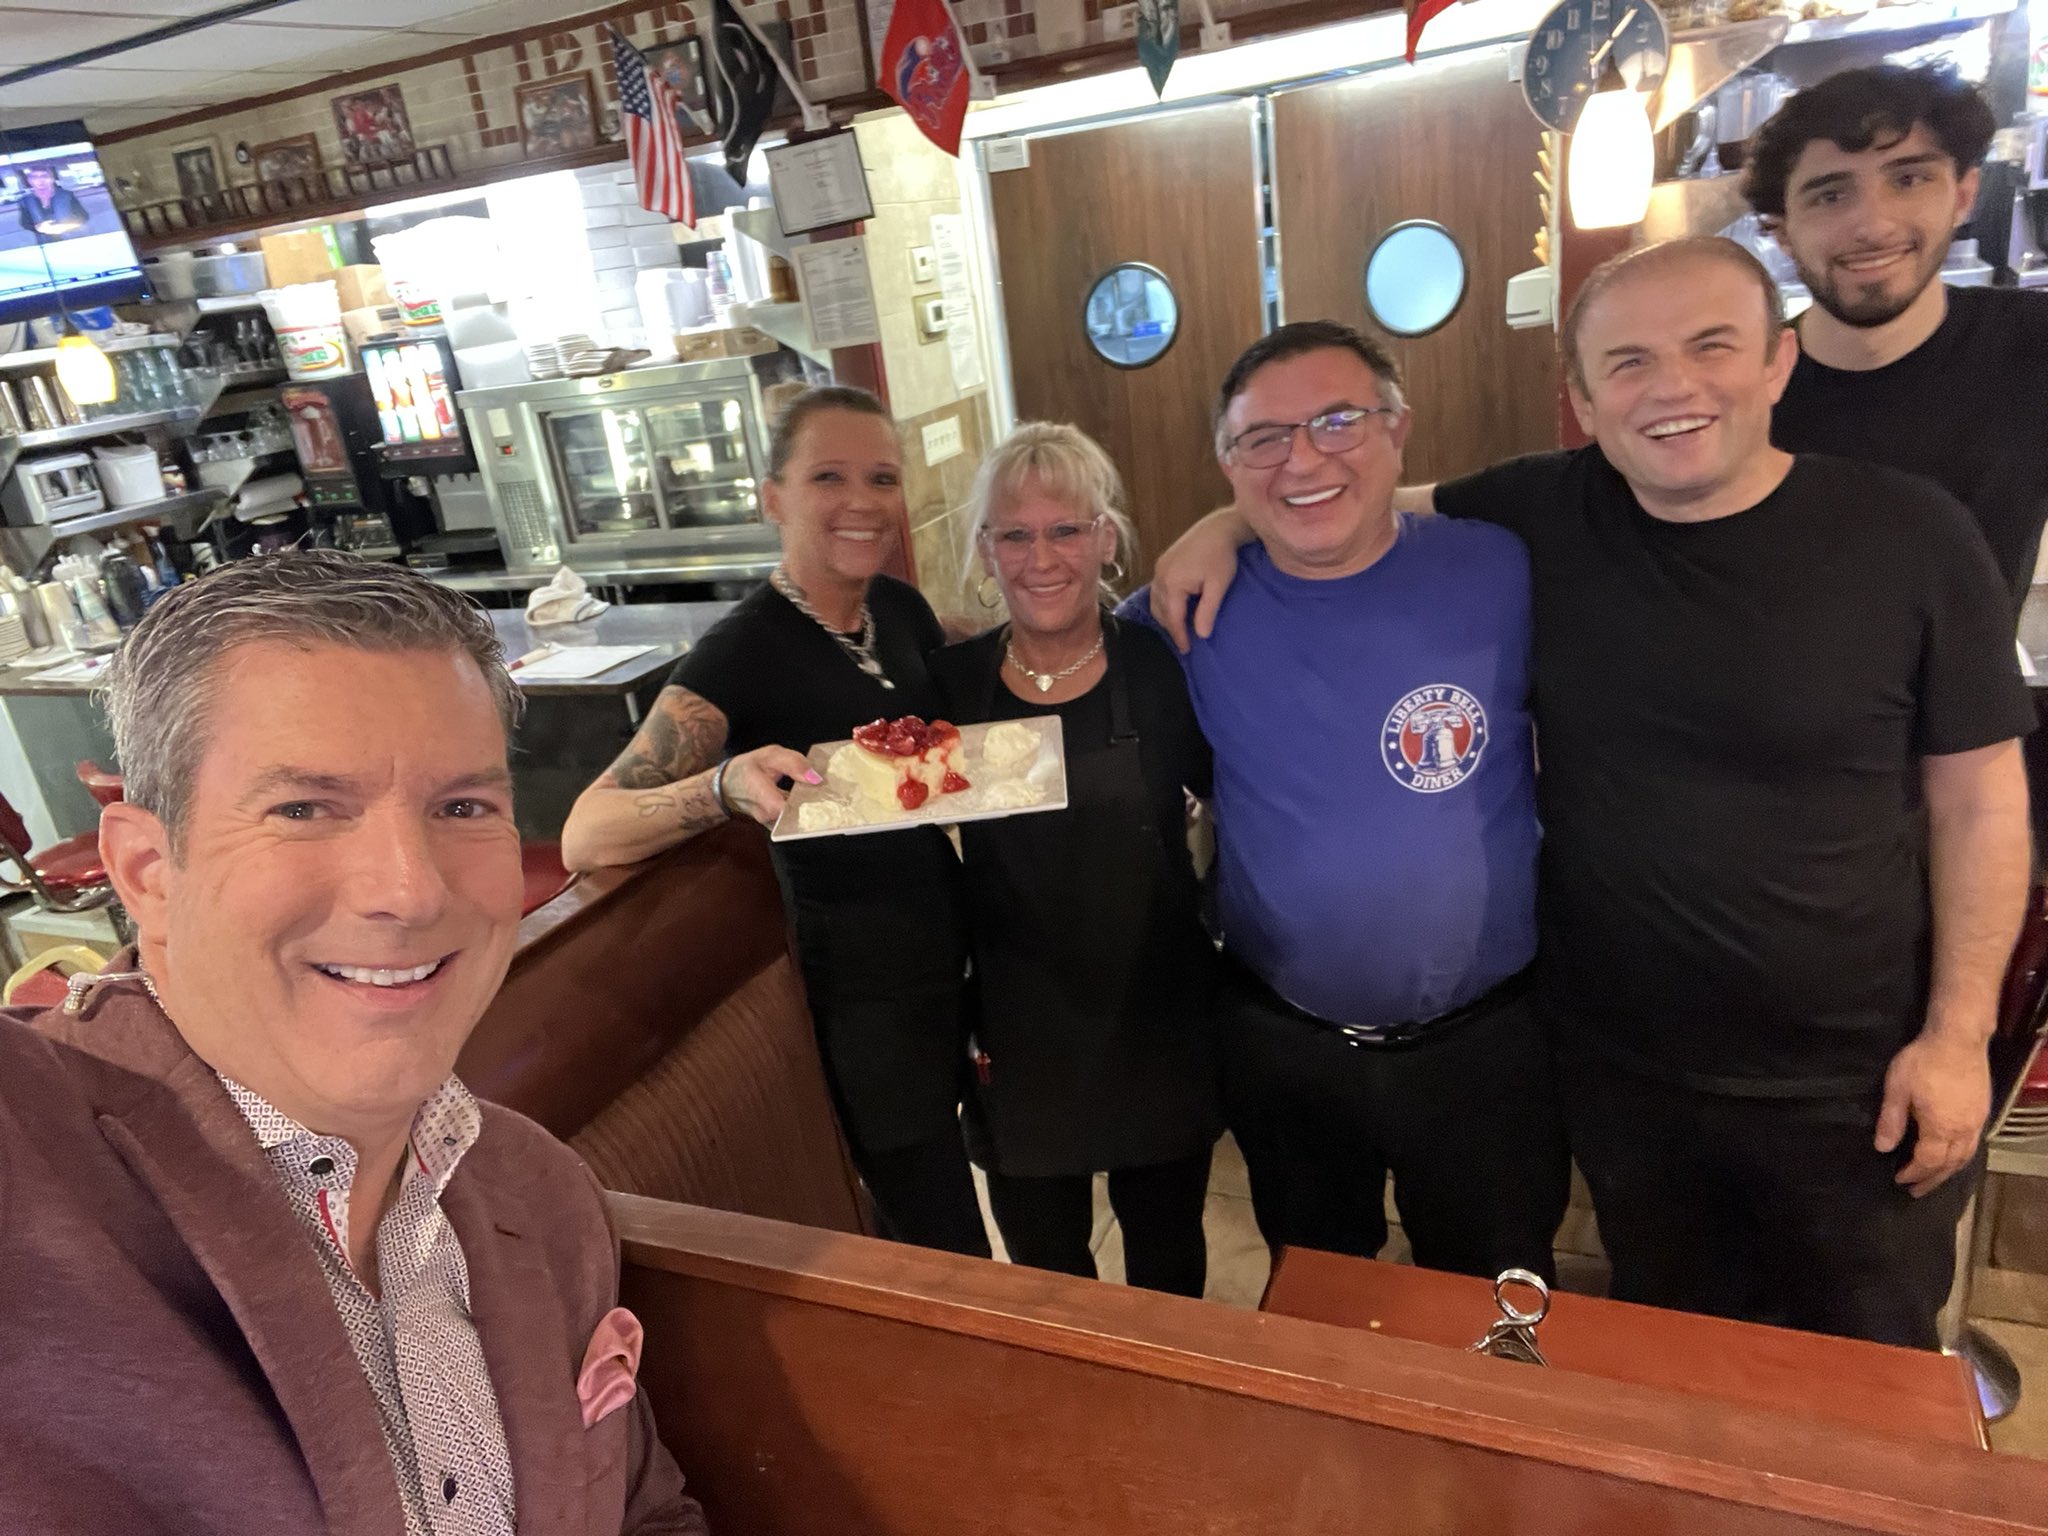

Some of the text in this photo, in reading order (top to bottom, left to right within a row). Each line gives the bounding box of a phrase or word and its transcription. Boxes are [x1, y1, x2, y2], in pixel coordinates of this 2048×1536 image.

[1387, 688, 1480, 734] LIBERTY BELL
[1411, 766, 1464, 790] DINER
